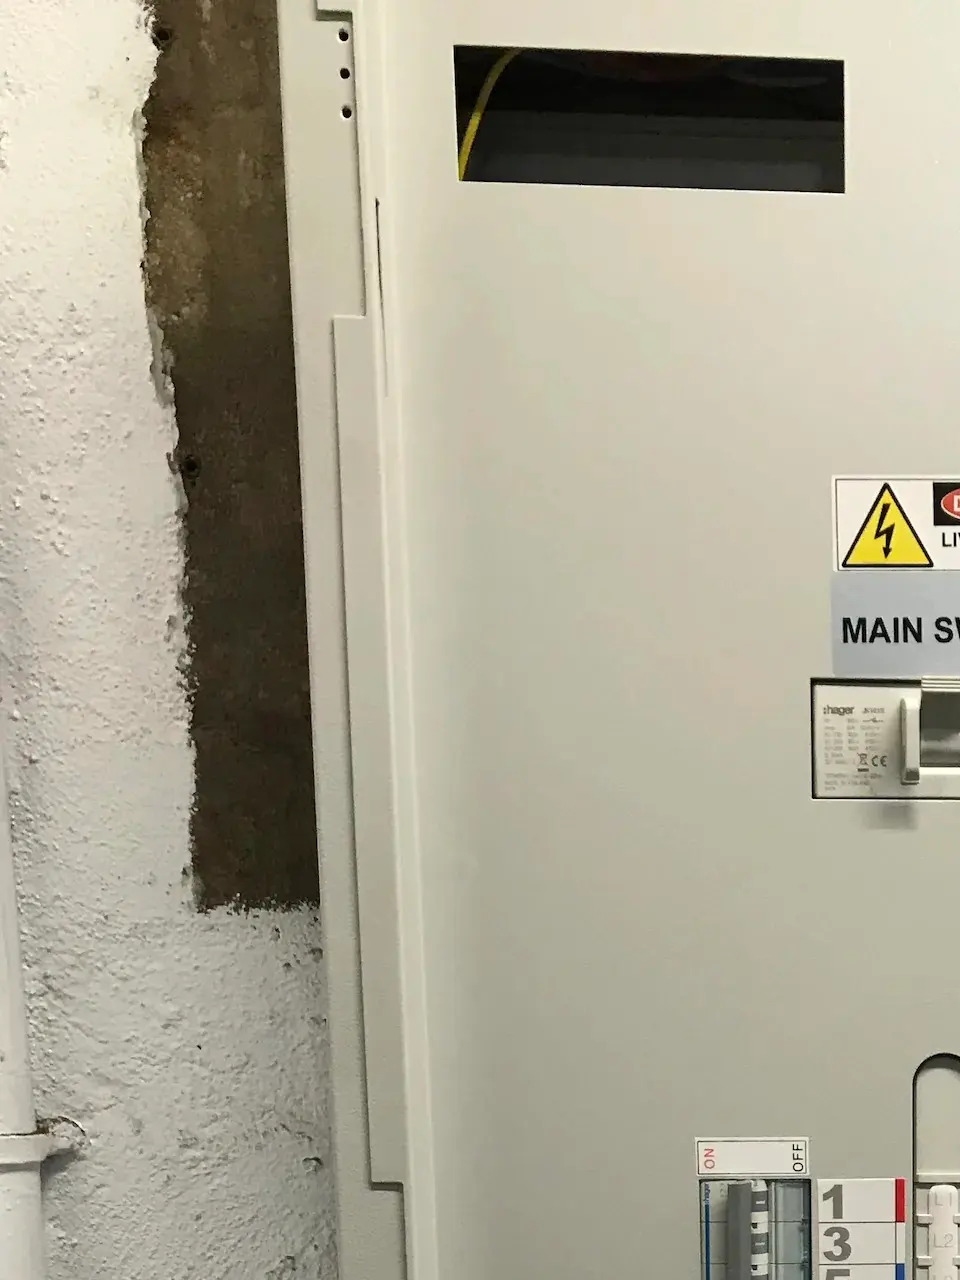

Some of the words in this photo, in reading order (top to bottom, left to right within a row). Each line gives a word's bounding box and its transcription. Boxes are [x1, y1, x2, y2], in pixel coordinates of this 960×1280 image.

[842, 617, 922, 643] MAIN
[703, 1148, 715, 1169] ON
[792, 1143, 804, 1172] OFF
[823, 1184, 843, 1219] 1
[934, 1192, 952, 1207] L1
[823, 1227, 851, 1261] 3
[934, 1234, 954, 1249] L2
